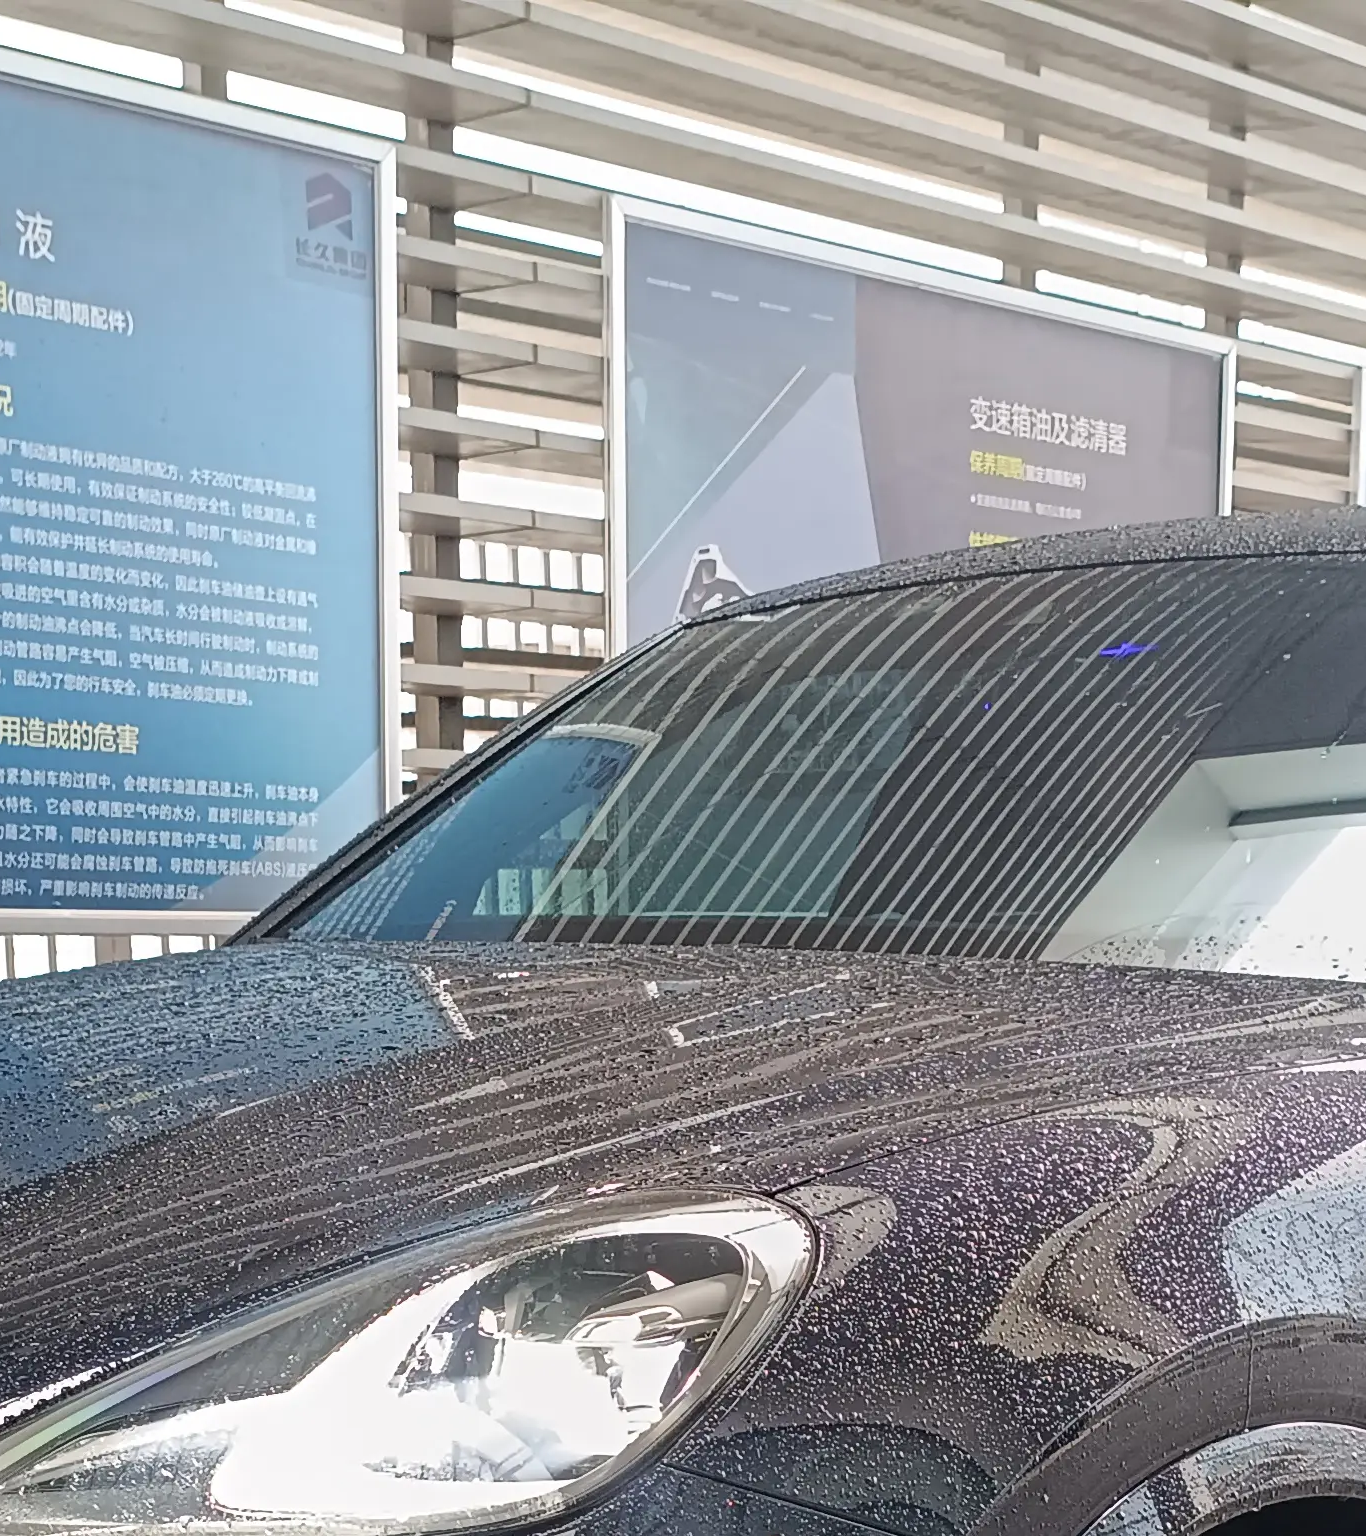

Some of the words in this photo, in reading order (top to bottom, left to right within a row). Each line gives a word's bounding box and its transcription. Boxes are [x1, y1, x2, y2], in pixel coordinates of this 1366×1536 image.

[969, 395, 1128, 457] 变速箱油及滤清器
